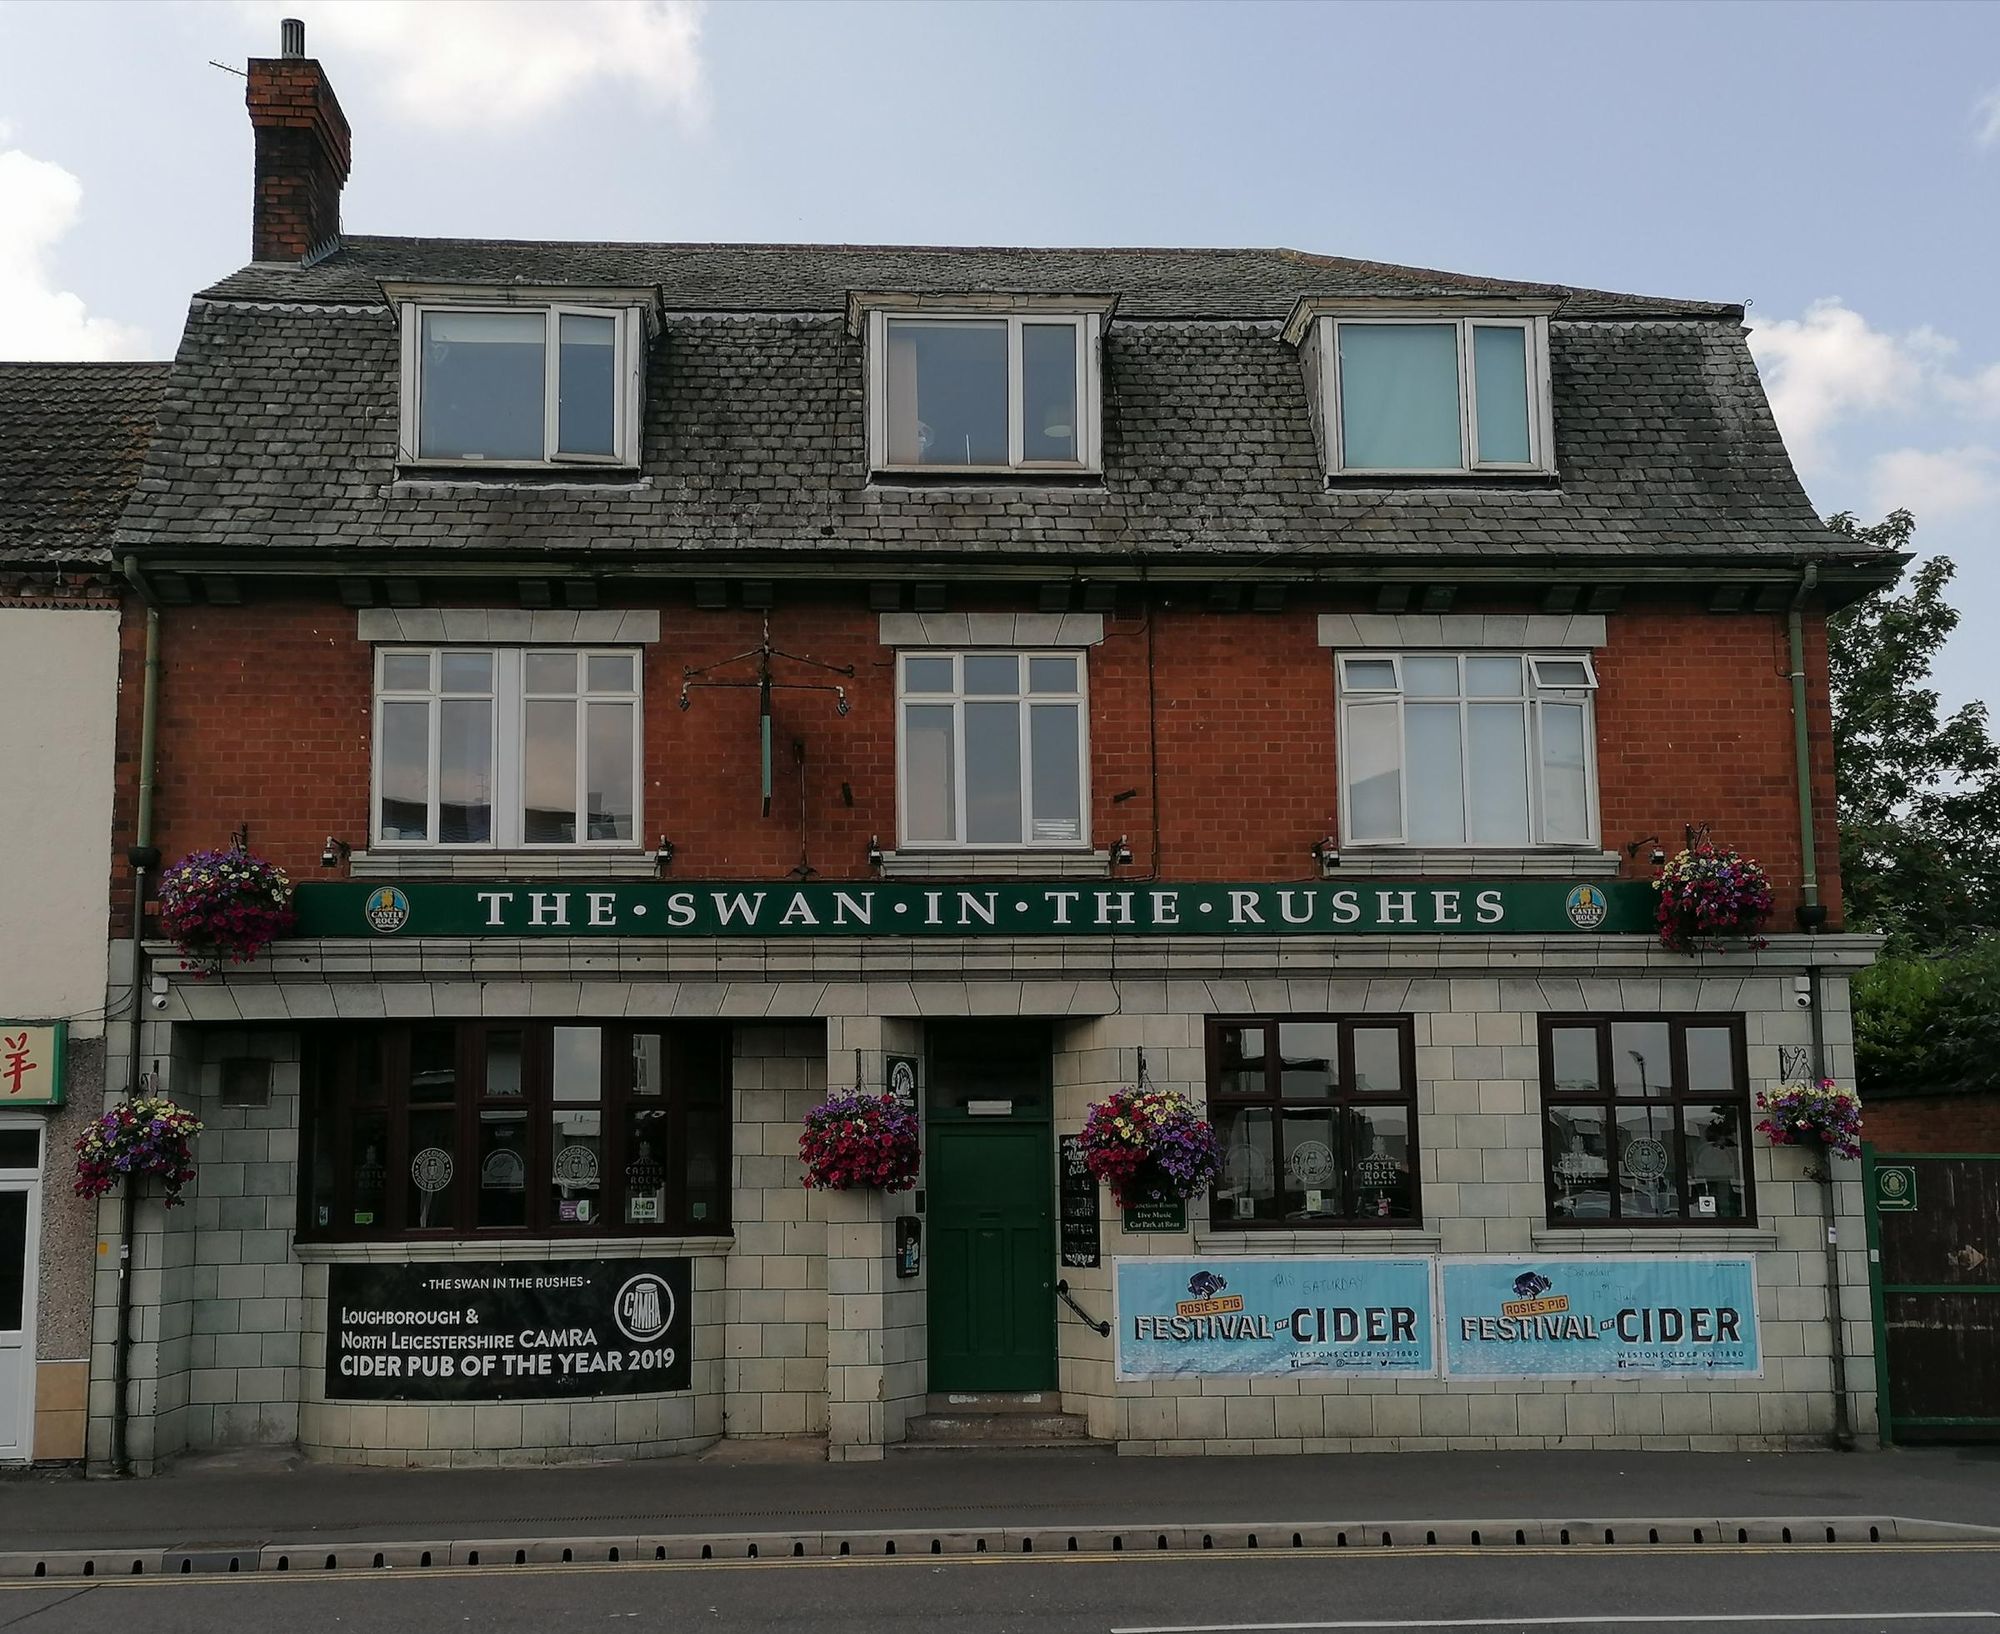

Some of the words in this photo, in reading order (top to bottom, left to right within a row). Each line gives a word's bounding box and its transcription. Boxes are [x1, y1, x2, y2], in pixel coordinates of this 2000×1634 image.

[371, 911, 403, 919] CASTLE
[477, 891, 616, 926] THE
[667, 891, 875, 926] SWAN
[924, 891, 999, 926] IN
[1045, 891, 1180, 925] THE
[1227, 890, 1506, 925] RUSHES
[416, 1150, 449, 1164] DISCOVER
[625, 1166, 664, 1176] CASTLE
[1358, 1161, 1401, 1170] CASTLE
[630, 1176, 658, 1184] ROCK
[1364, 1171, 1396, 1180] ROCK
[428, 1278, 451, 1290] THE
[454, 1278, 489, 1290] SWAN
[492, 1277, 506, 1289] IN
[509, 1277, 532, 1289] THE
[535, 1276, 584, 1289] RUSHES
[1303, 1273, 1364, 1296] SATURDAY
[623, 1291, 662, 1330] CAMRA
[1180, 1300, 1219, 1315] ROSIE'S
[1222, 1298, 1240, 1310] PIG
[1506, 1300, 1545, 1315] ROSIE'S
[1549, 1298, 1566, 1310] PIG
[465, 1308, 479, 1324] &
[1135, 1314, 1274, 1342] FESTIVAL
[1276, 1319, 1287, 1330] OF
[1290, 1306, 1419, 1344] CIDER
[1461, 1314, 1600, 1342] FESTIVAL
[1602, 1319, 1613, 1330] OF
[1616, 1306, 1742, 1344] CIDER
[341, 1331, 387, 1350] NORTH
[519, 1328, 598, 1348] CAMRA
[340, 1354, 401, 1377] CIDER
[407, 1355, 455, 1377] PUB
[460, 1354, 497, 1377] OF
[502, 1353, 552, 1376] THE
[558, 1351, 623, 1374] YEAR
[628, 1347, 675, 1371] 2019
[1290, 1350, 1338, 1358] WESTONS
[1342, 1350, 1372, 1358] CIDER
[1617, 1350, 1664, 1359] WESTONS
[1668, 1350, 1698, 1358] CIDER
[1720, 1350, 1744, 1358] 1880
